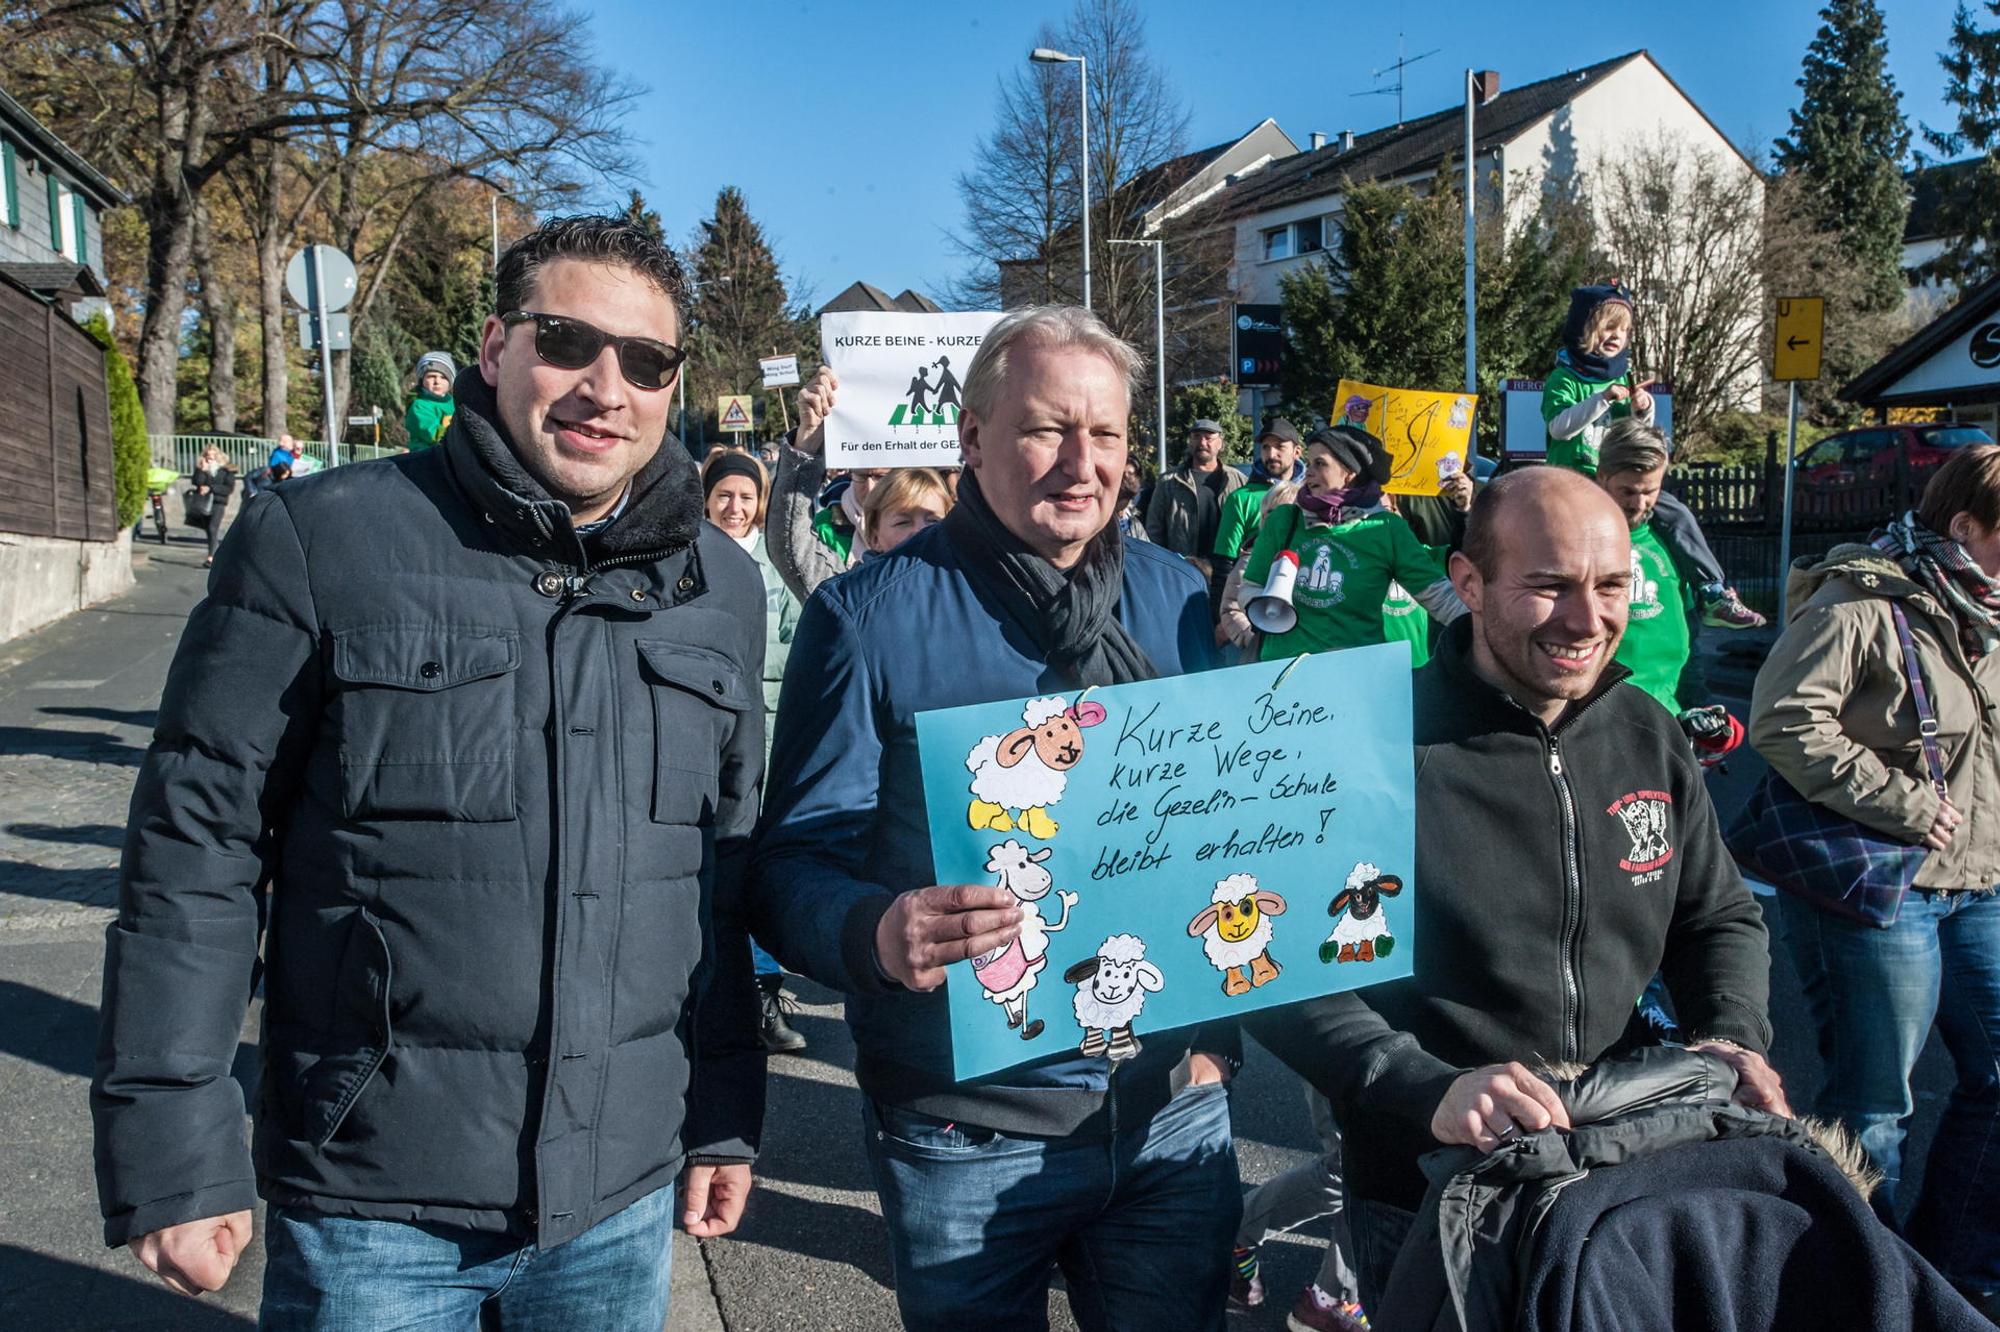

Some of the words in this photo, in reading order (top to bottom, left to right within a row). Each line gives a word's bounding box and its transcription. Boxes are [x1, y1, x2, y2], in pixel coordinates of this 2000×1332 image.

[1780, 300, 1790, 317] U
[835, 336, 881, 347] KURZE
[885, 336, 925, 346] BEINE
[937, 335, 982, 346] KURZE
[841, 442, 859, 451] Für
[862, 441, 882, 450] den
[885, 439, 917, 450] Erhalt
[920, 440, 937, 449] der
[1115, 702, 1222, 756] Kurze
[1097, 799, 1138, 826] die
[1270, 773, 1337, 799] Schule
[1091, 843, 1172, 880] bleibt
